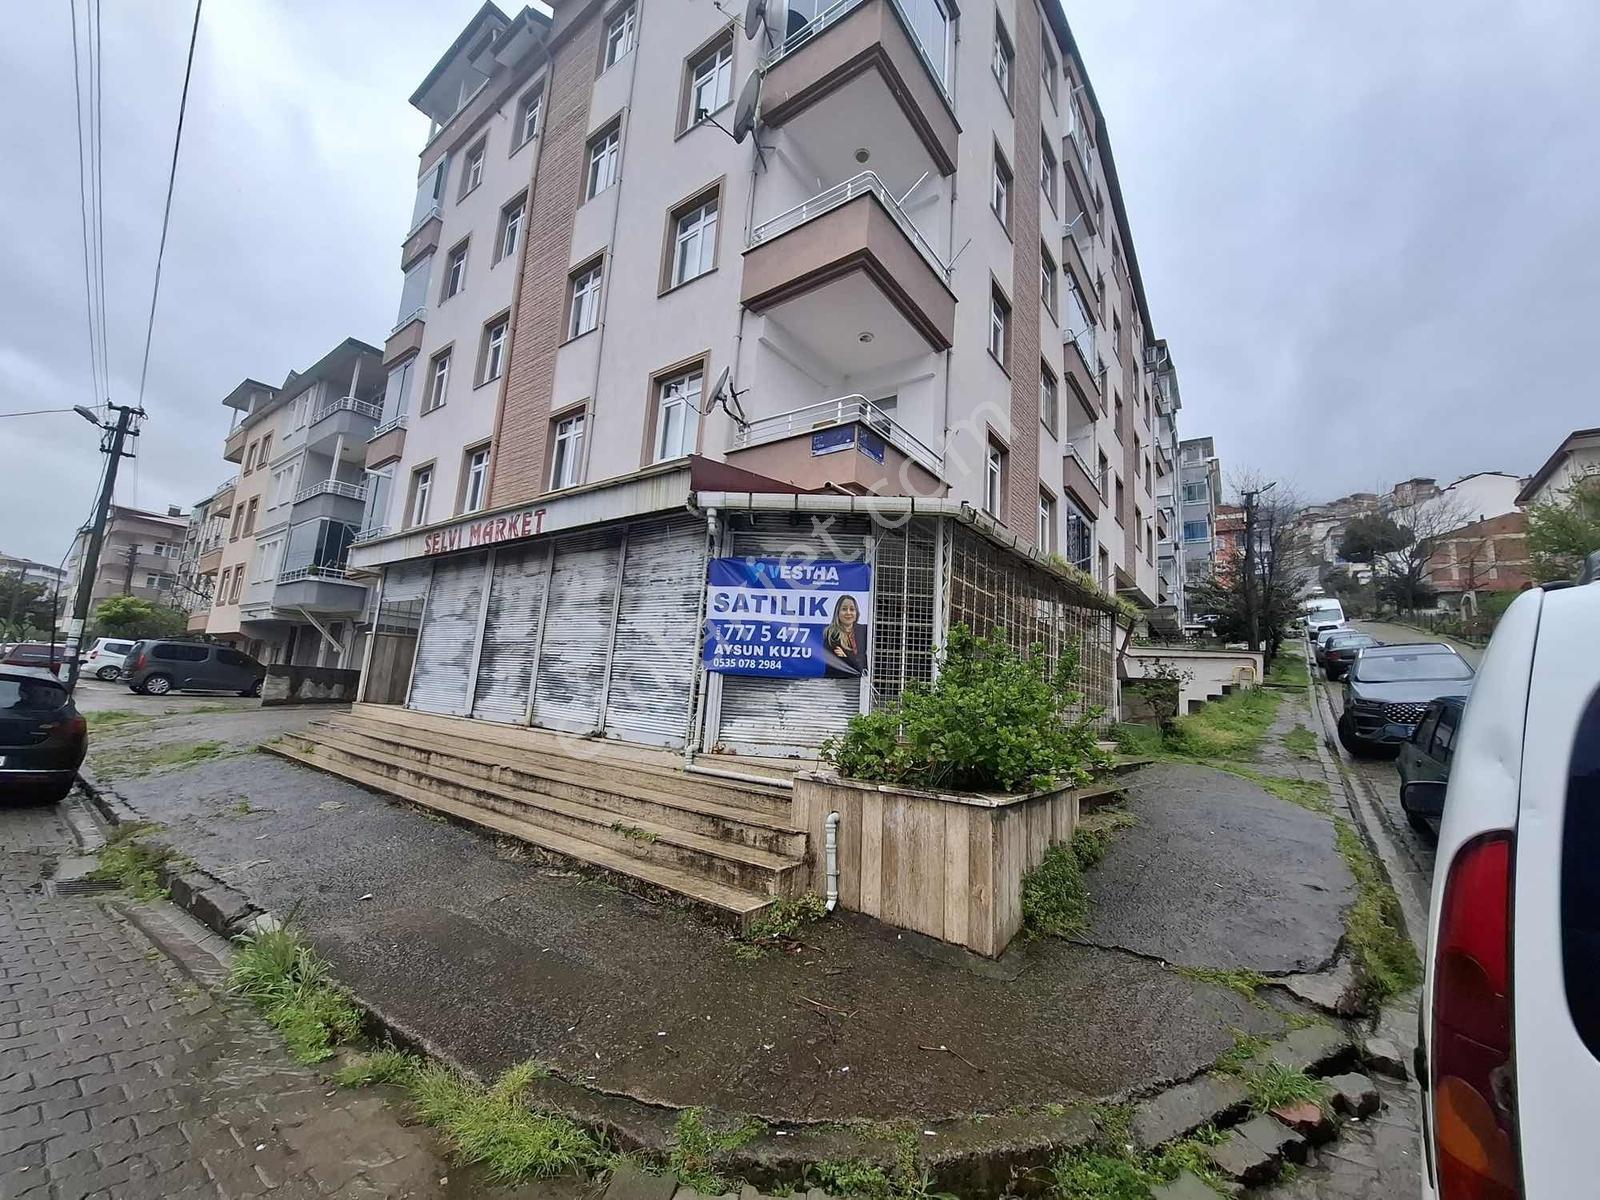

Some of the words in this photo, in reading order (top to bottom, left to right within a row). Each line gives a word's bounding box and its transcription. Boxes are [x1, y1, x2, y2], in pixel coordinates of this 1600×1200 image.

[424, 527, 463, 554] SELVI
[469, 509, 547, 546] MARKET
[768, 564, 840, 581] VESTHA
[713, 592, 829, 617] SATILIK
[723, 624, 756, 641] 777
[760, 625, 772, 642] 5
[776, 626, 810, 644] 477
[713, 643, 764, 656] AYSUN
[769, 645, 812, 658] KUZU
[713, 657, 736, 668] 0535
[738, 659, 756, 669] 078
[758, 660, 782, 670] 2984
